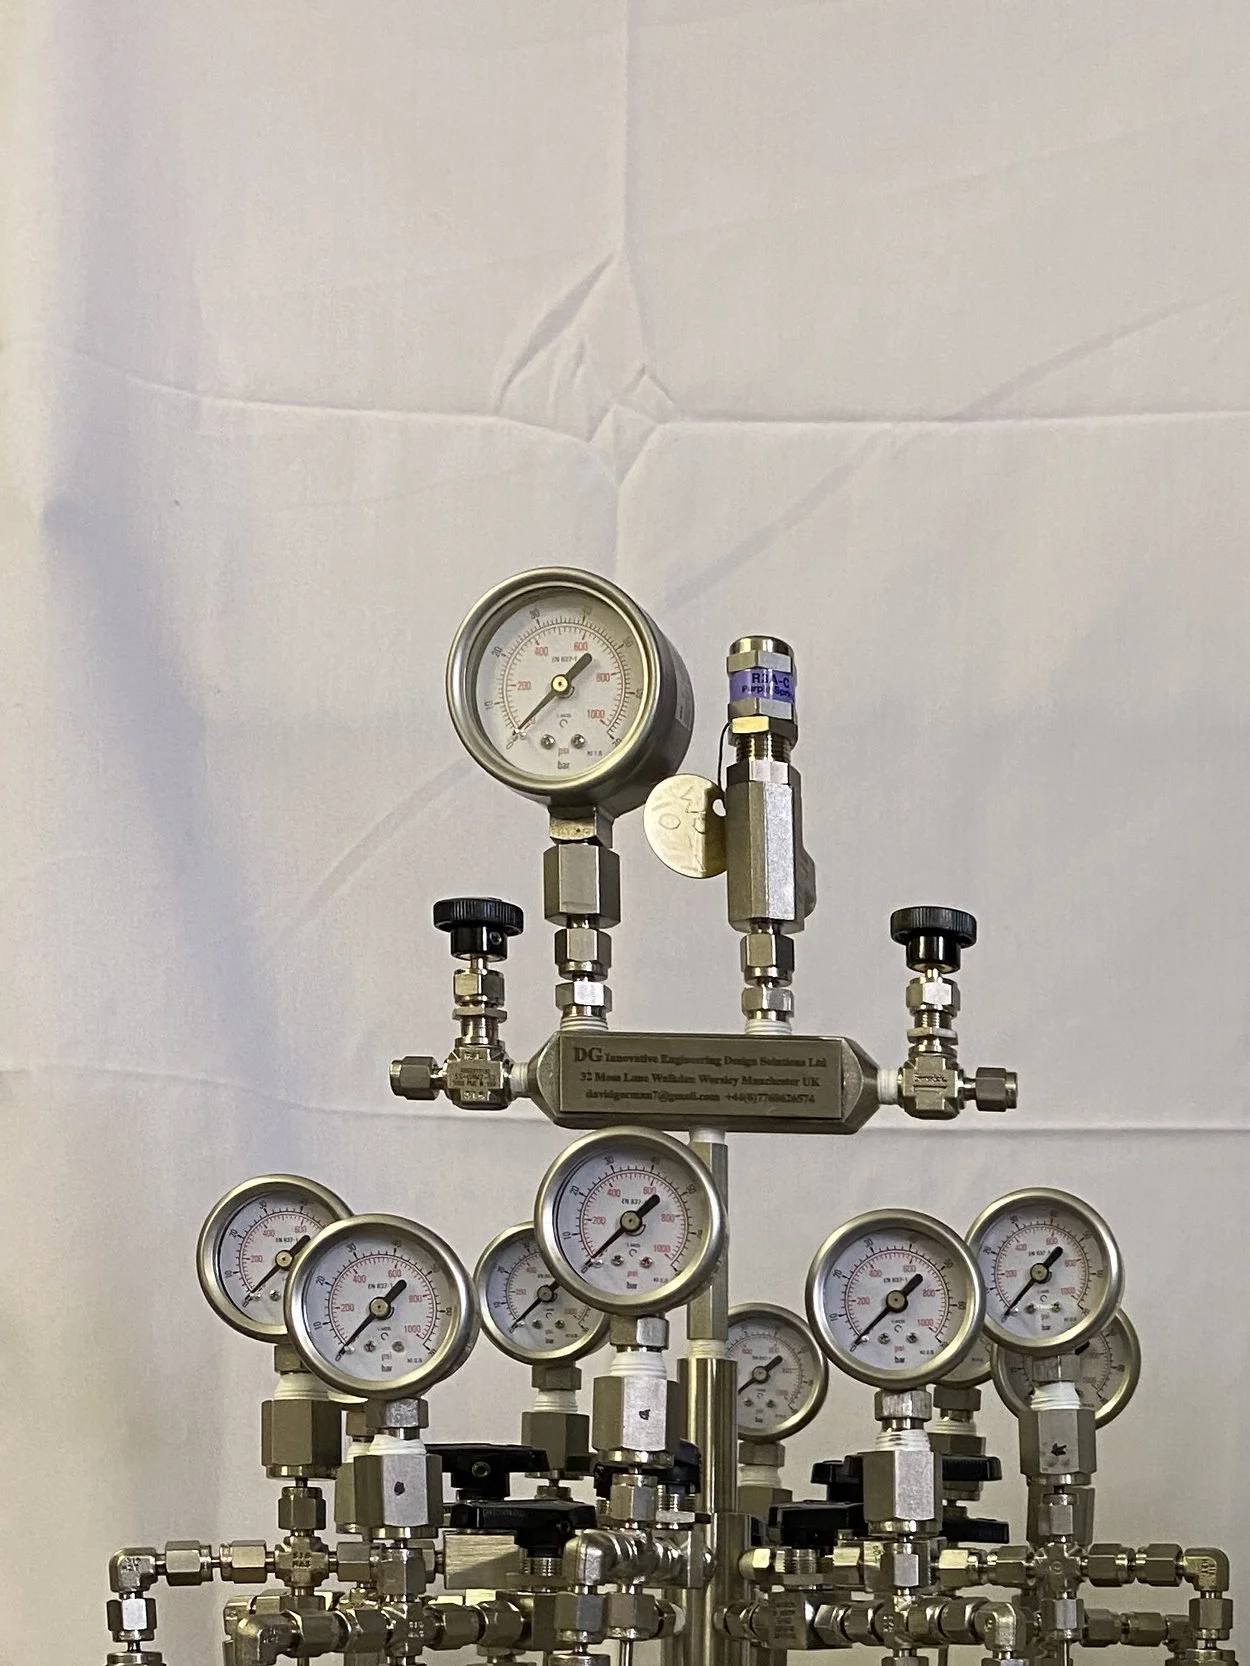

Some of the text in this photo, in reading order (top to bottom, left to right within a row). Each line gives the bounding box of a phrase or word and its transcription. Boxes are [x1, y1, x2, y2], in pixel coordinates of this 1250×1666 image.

[491, 646, 503, 658] 20
[752, 673, 789, 688] R3A-C
[517, 681, 532, 691] 200
[587, 709, 606, 720] 1000
[557, 760, 570, 770] bar
[574, 1047, 603, 1062] DG
[724, 1055, 758, 1067] Design
[808, 1057, 827, 1067] Ltd
[623, 1072, 649, 1082] Lane
[802, 1077, 820, 1087] UK
[592, 1216, 606, 1226] 200
[315, 1275, 326, 1286] 20
[856, 1296, 870, 1305] 200
[340, 1303, 354, 1312] 200
[314, 1321, 322, 1331] 10
[404, 1325, 422, 1334] 1000
[894, 1356, 906, 1364] bar
[381, 1363, 393, 1372] bar
